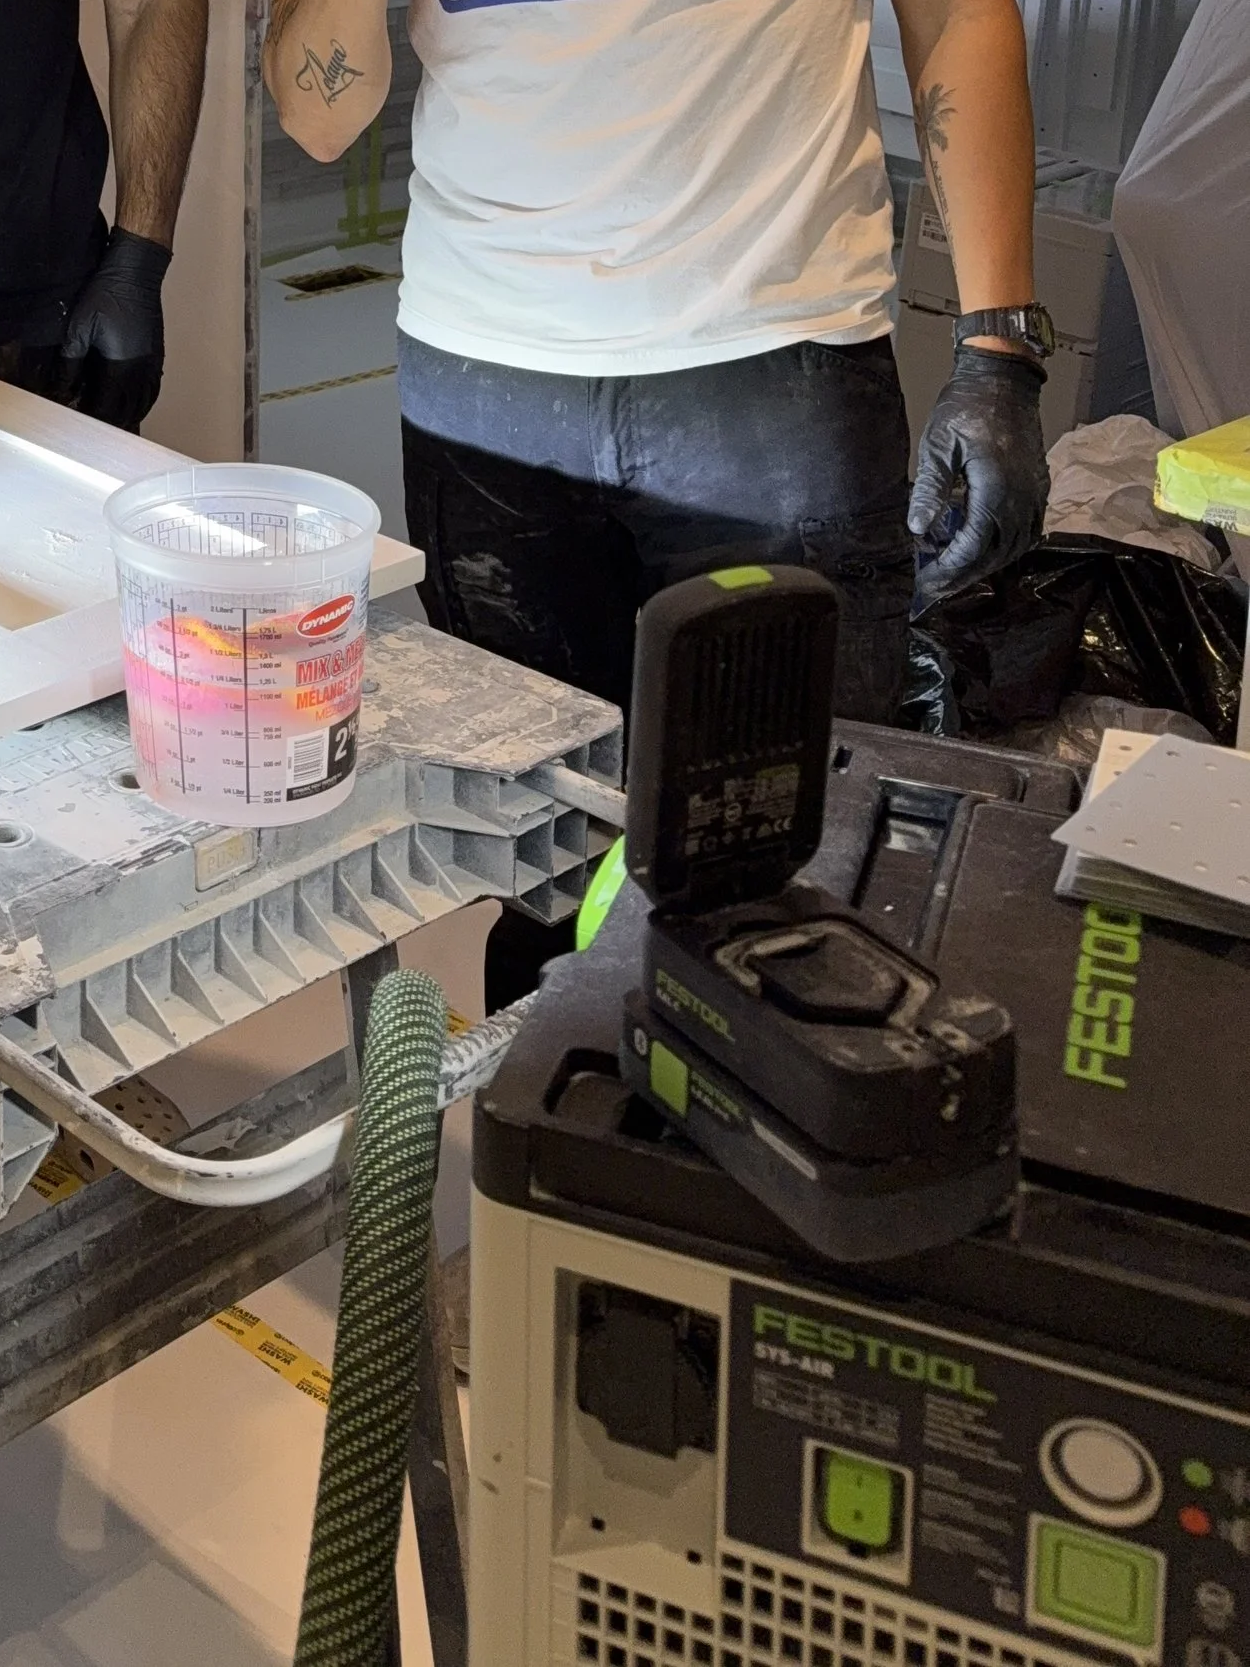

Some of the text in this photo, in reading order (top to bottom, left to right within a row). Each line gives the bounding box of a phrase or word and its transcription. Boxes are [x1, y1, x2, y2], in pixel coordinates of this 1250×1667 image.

[301, 600, 354, 631] DYNAMIC
[297, 654, 331, 686] MIX
[656, 967, 736, 1045] FESTOOL
[1064, 901, 1142, 1090] FESTOO
[258, 1344, 291, 1366] WASHI
[753, 1341, 836, 1380] SYS-AIR
[754, 1303, 998, 1404] FESTOOL
[296, 1383, 330, 1405] WASHI
